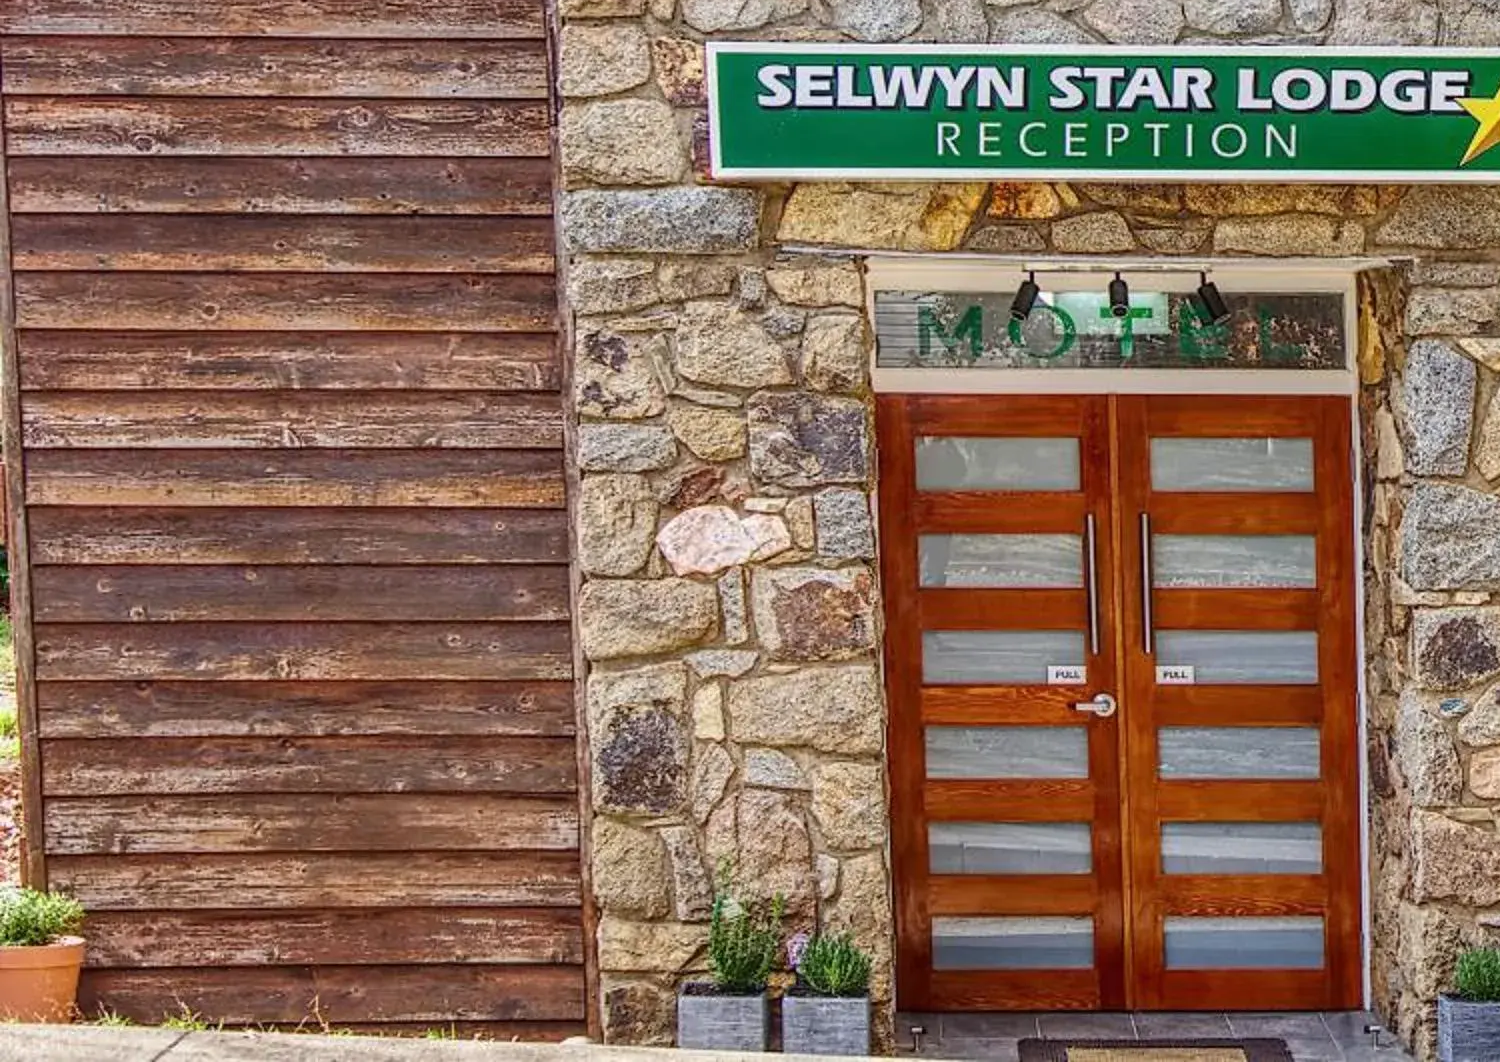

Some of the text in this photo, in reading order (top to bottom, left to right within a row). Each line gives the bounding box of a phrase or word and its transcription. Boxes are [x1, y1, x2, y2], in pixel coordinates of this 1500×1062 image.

[756, 65, 1471, 113] SELWYN STAR LODGE
[936, 122, 1297, 158] RECEPTION
[1055, 670, 1080, 679] PULL
[1163, 670, 1188, 679] PULL
